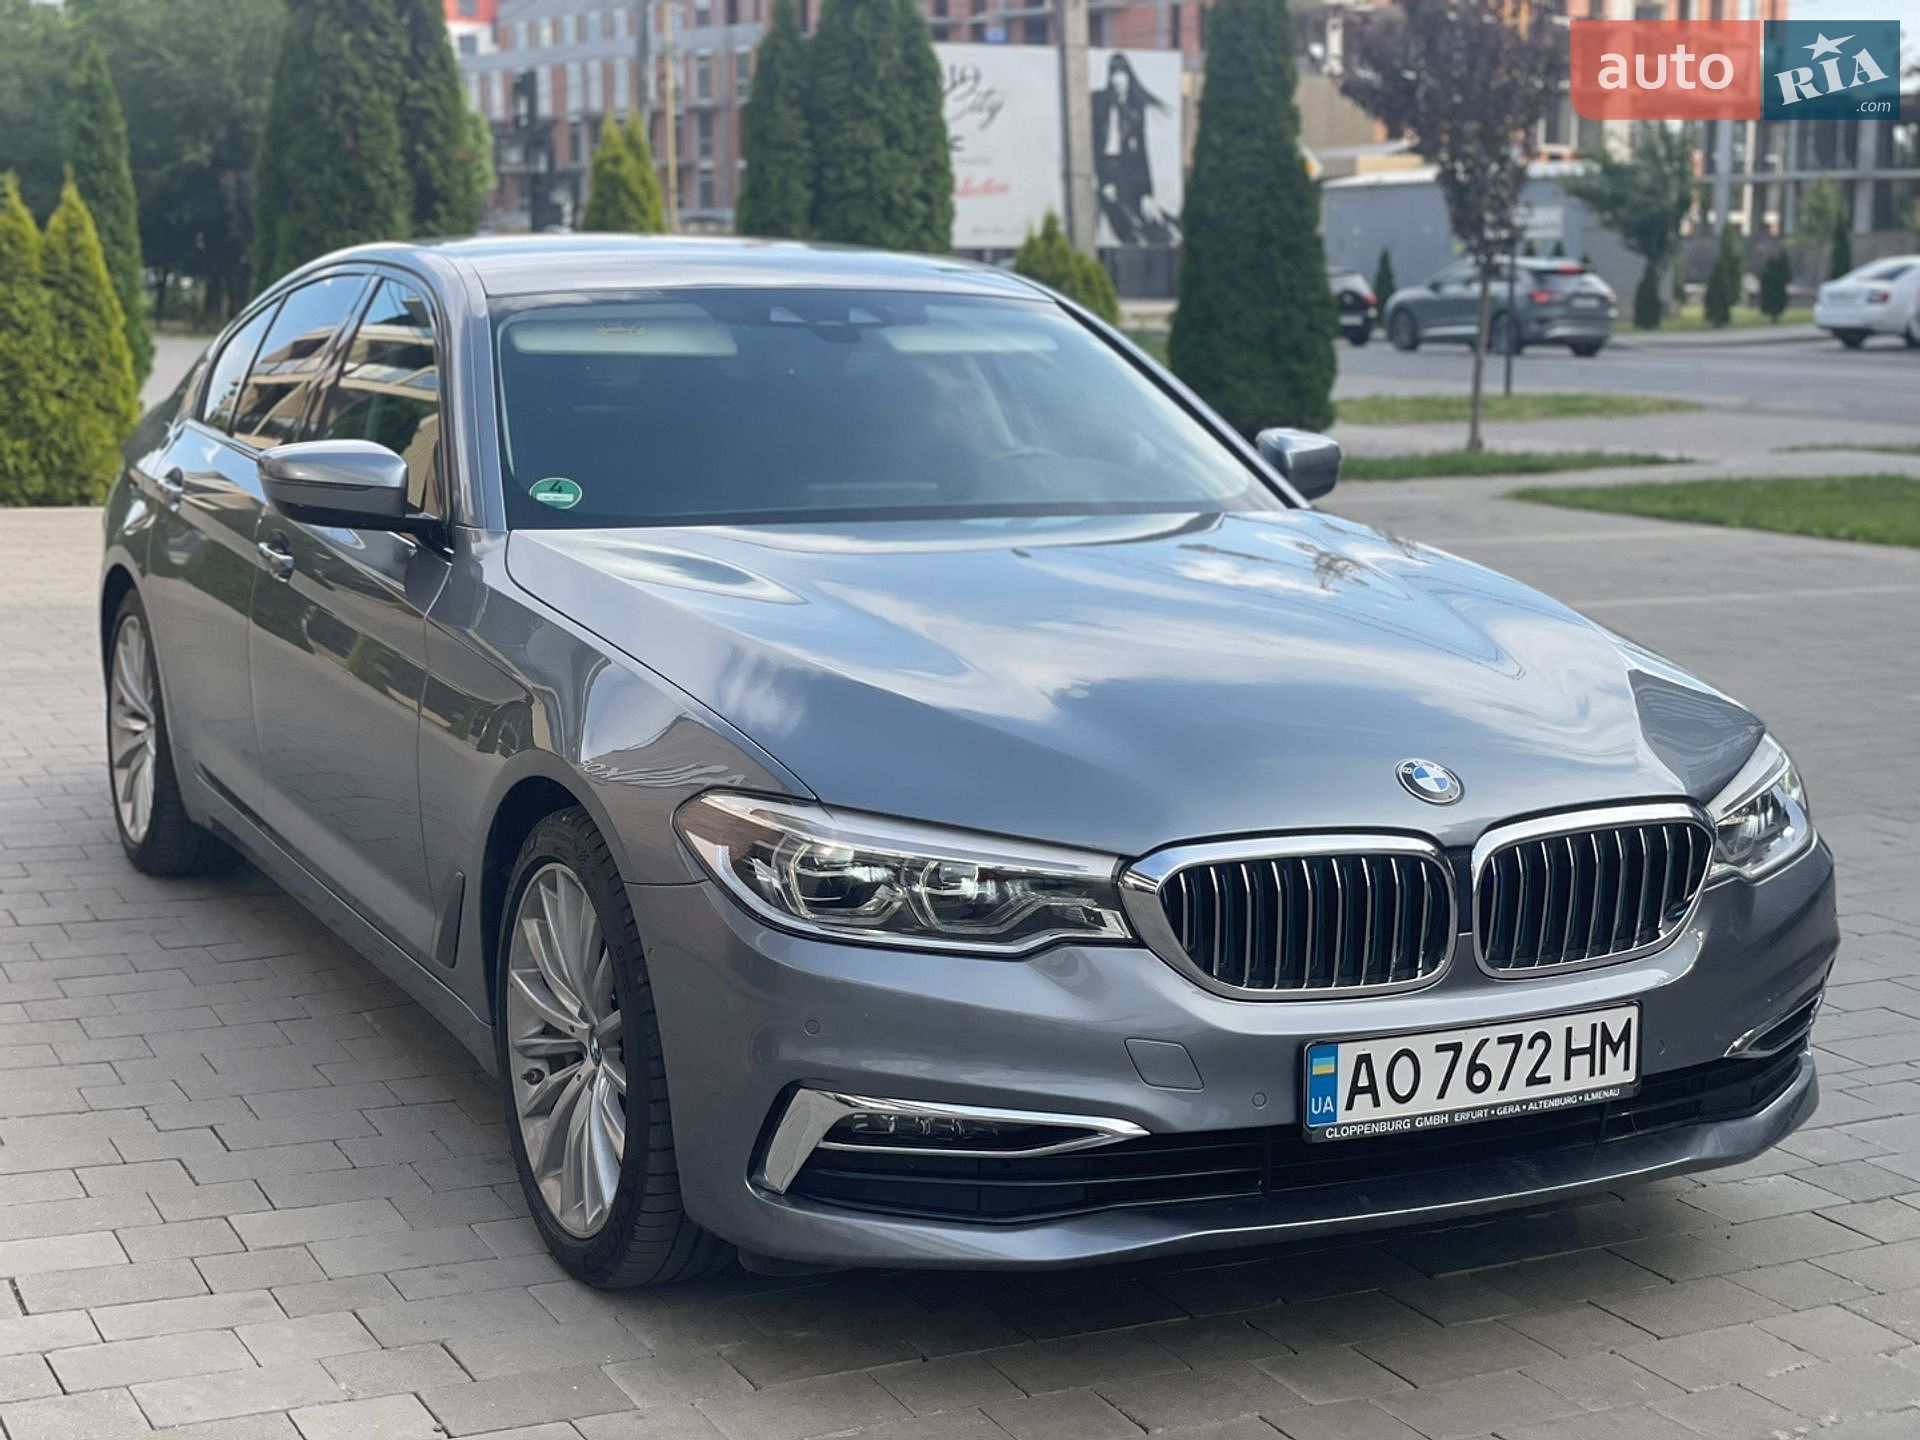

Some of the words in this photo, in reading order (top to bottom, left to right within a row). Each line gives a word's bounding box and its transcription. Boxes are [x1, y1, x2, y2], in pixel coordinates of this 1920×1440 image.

[549, 480, 563, 493] 4
[1344, 1047, 1421, 1111] AO
[1435, 1030, 1552, 1100] 7672
[1564, 1017, 1632, 1081] HM
[1311, 1095, 1334, 1115] UA
[1325, 1118, 1411, 1139] CLOPPENBURG
[1415, 1113, 1449, 1128] GMBH
[1454, 1108, 1488, 1122] ERFURT
[1496, 1104, 1521, 1116] GERA
[1527, 1095, 1578, 1111] ALTENBURG
[1583, 1088, 1620, 1102] ILMENAU
